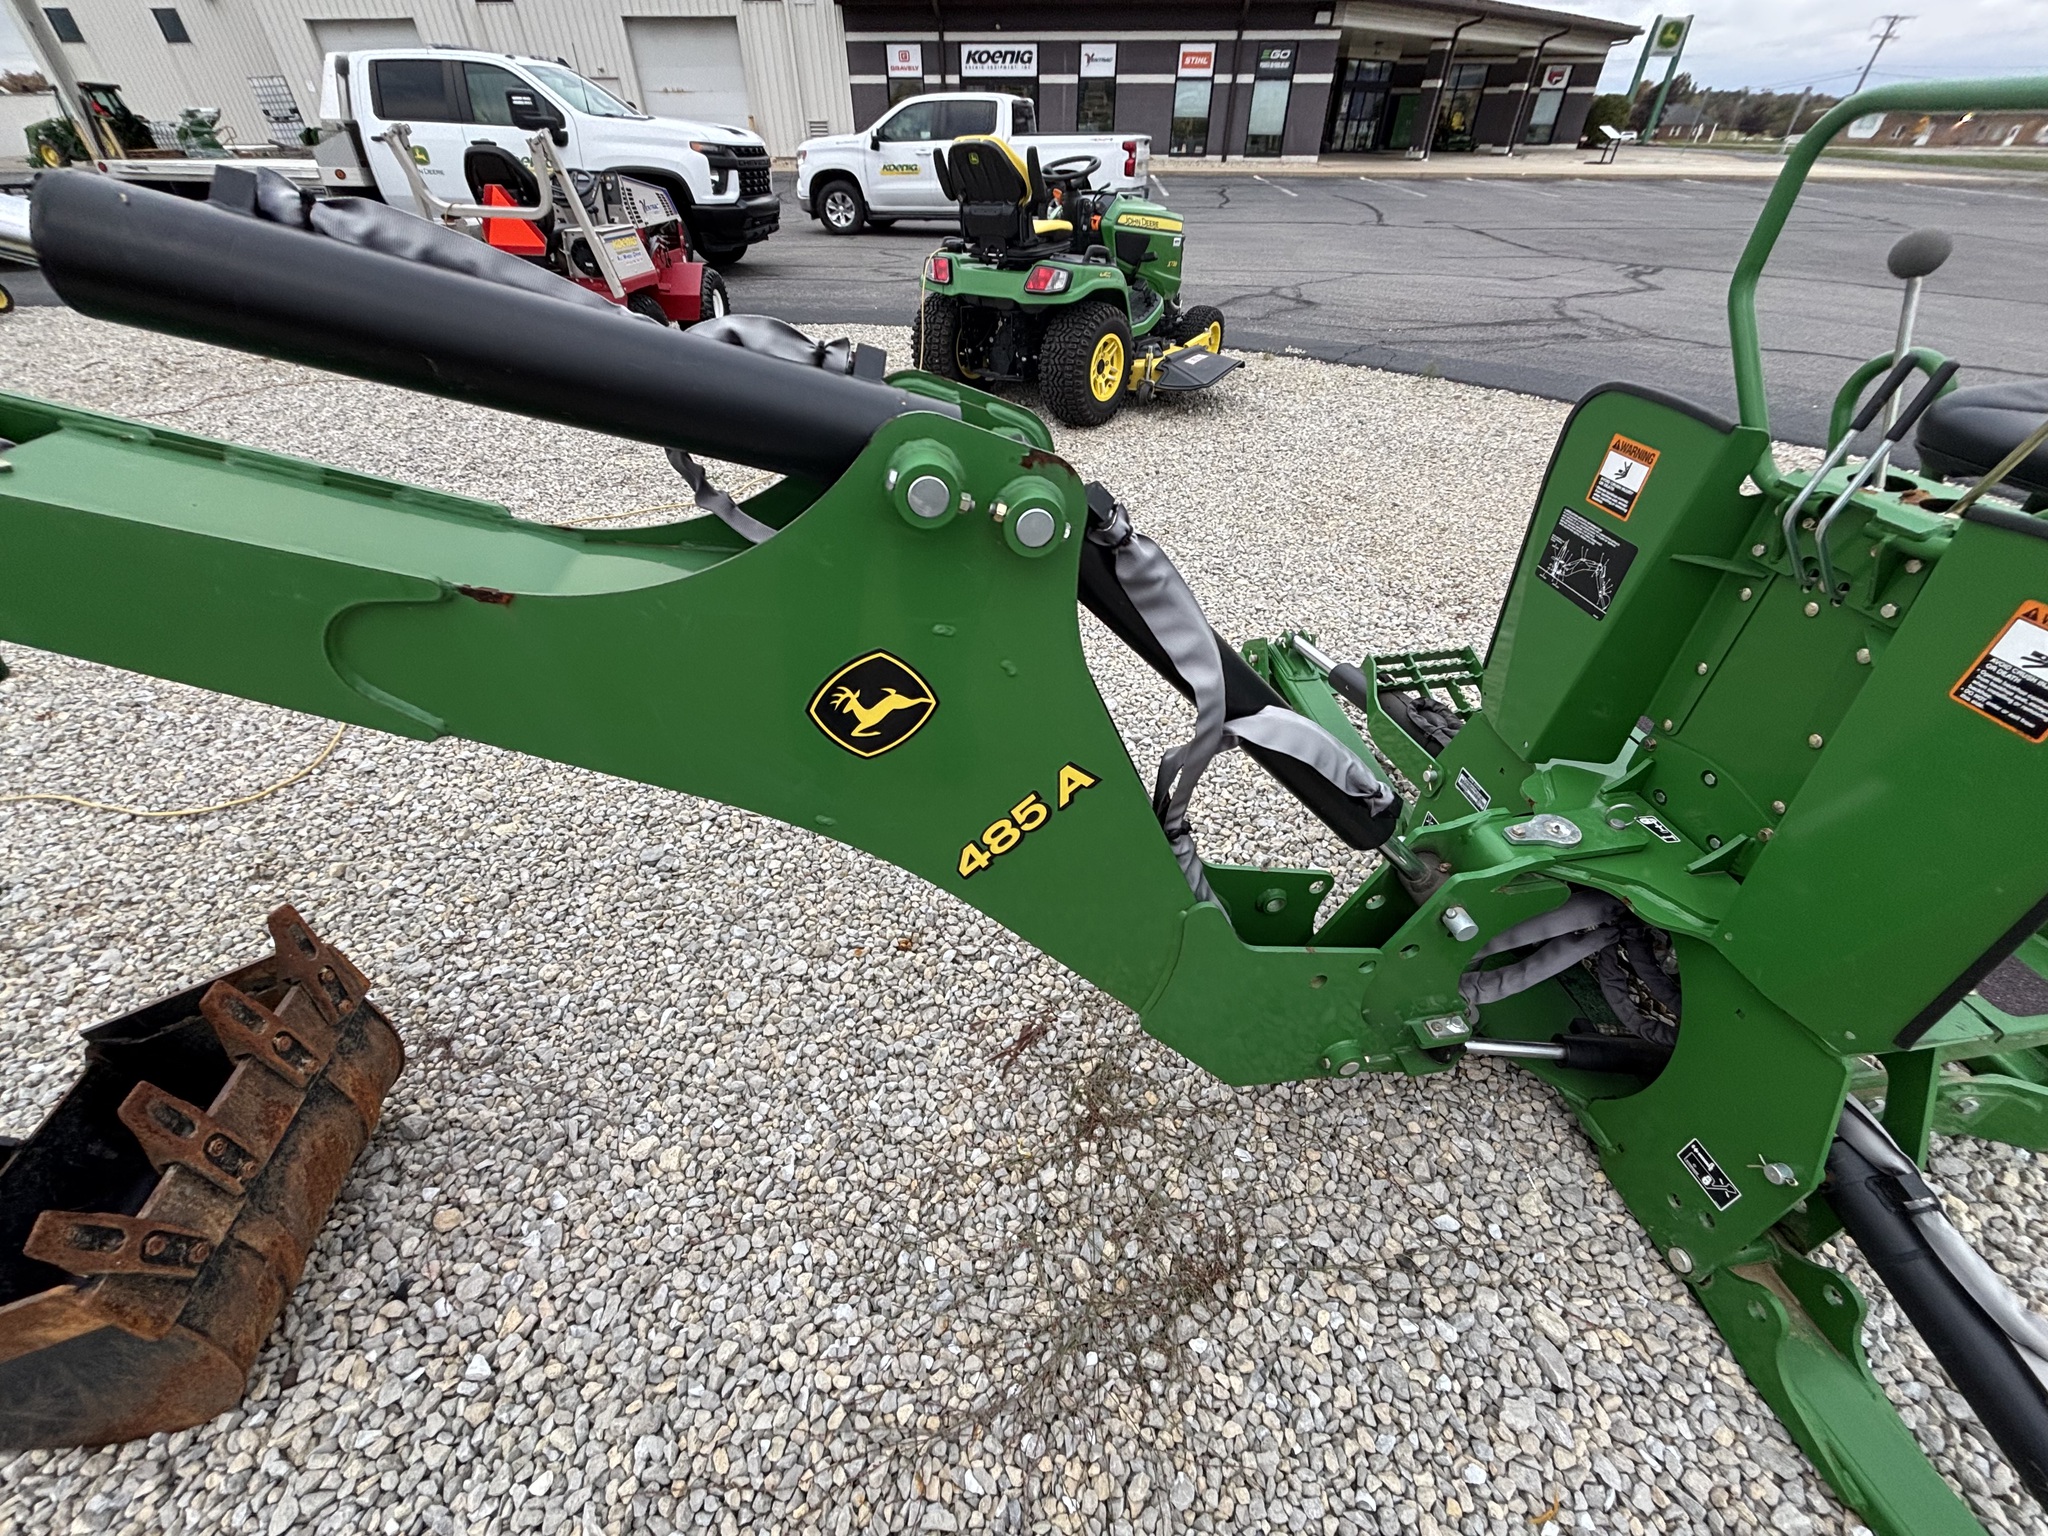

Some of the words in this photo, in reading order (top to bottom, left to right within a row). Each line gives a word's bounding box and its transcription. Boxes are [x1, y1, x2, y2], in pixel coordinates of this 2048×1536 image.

[1184, 56, 1209, 65] STIHL
[1261, 49, 1291, 59] EGO
[1124, 215, 1141, 226] JOHN
[1141, 217, 1159, 228] DEERE
[1620, 440, 1656, 465] WARNING
[957, 790, 1052, 880] 485
[1057, 761, 1103, 811] A
